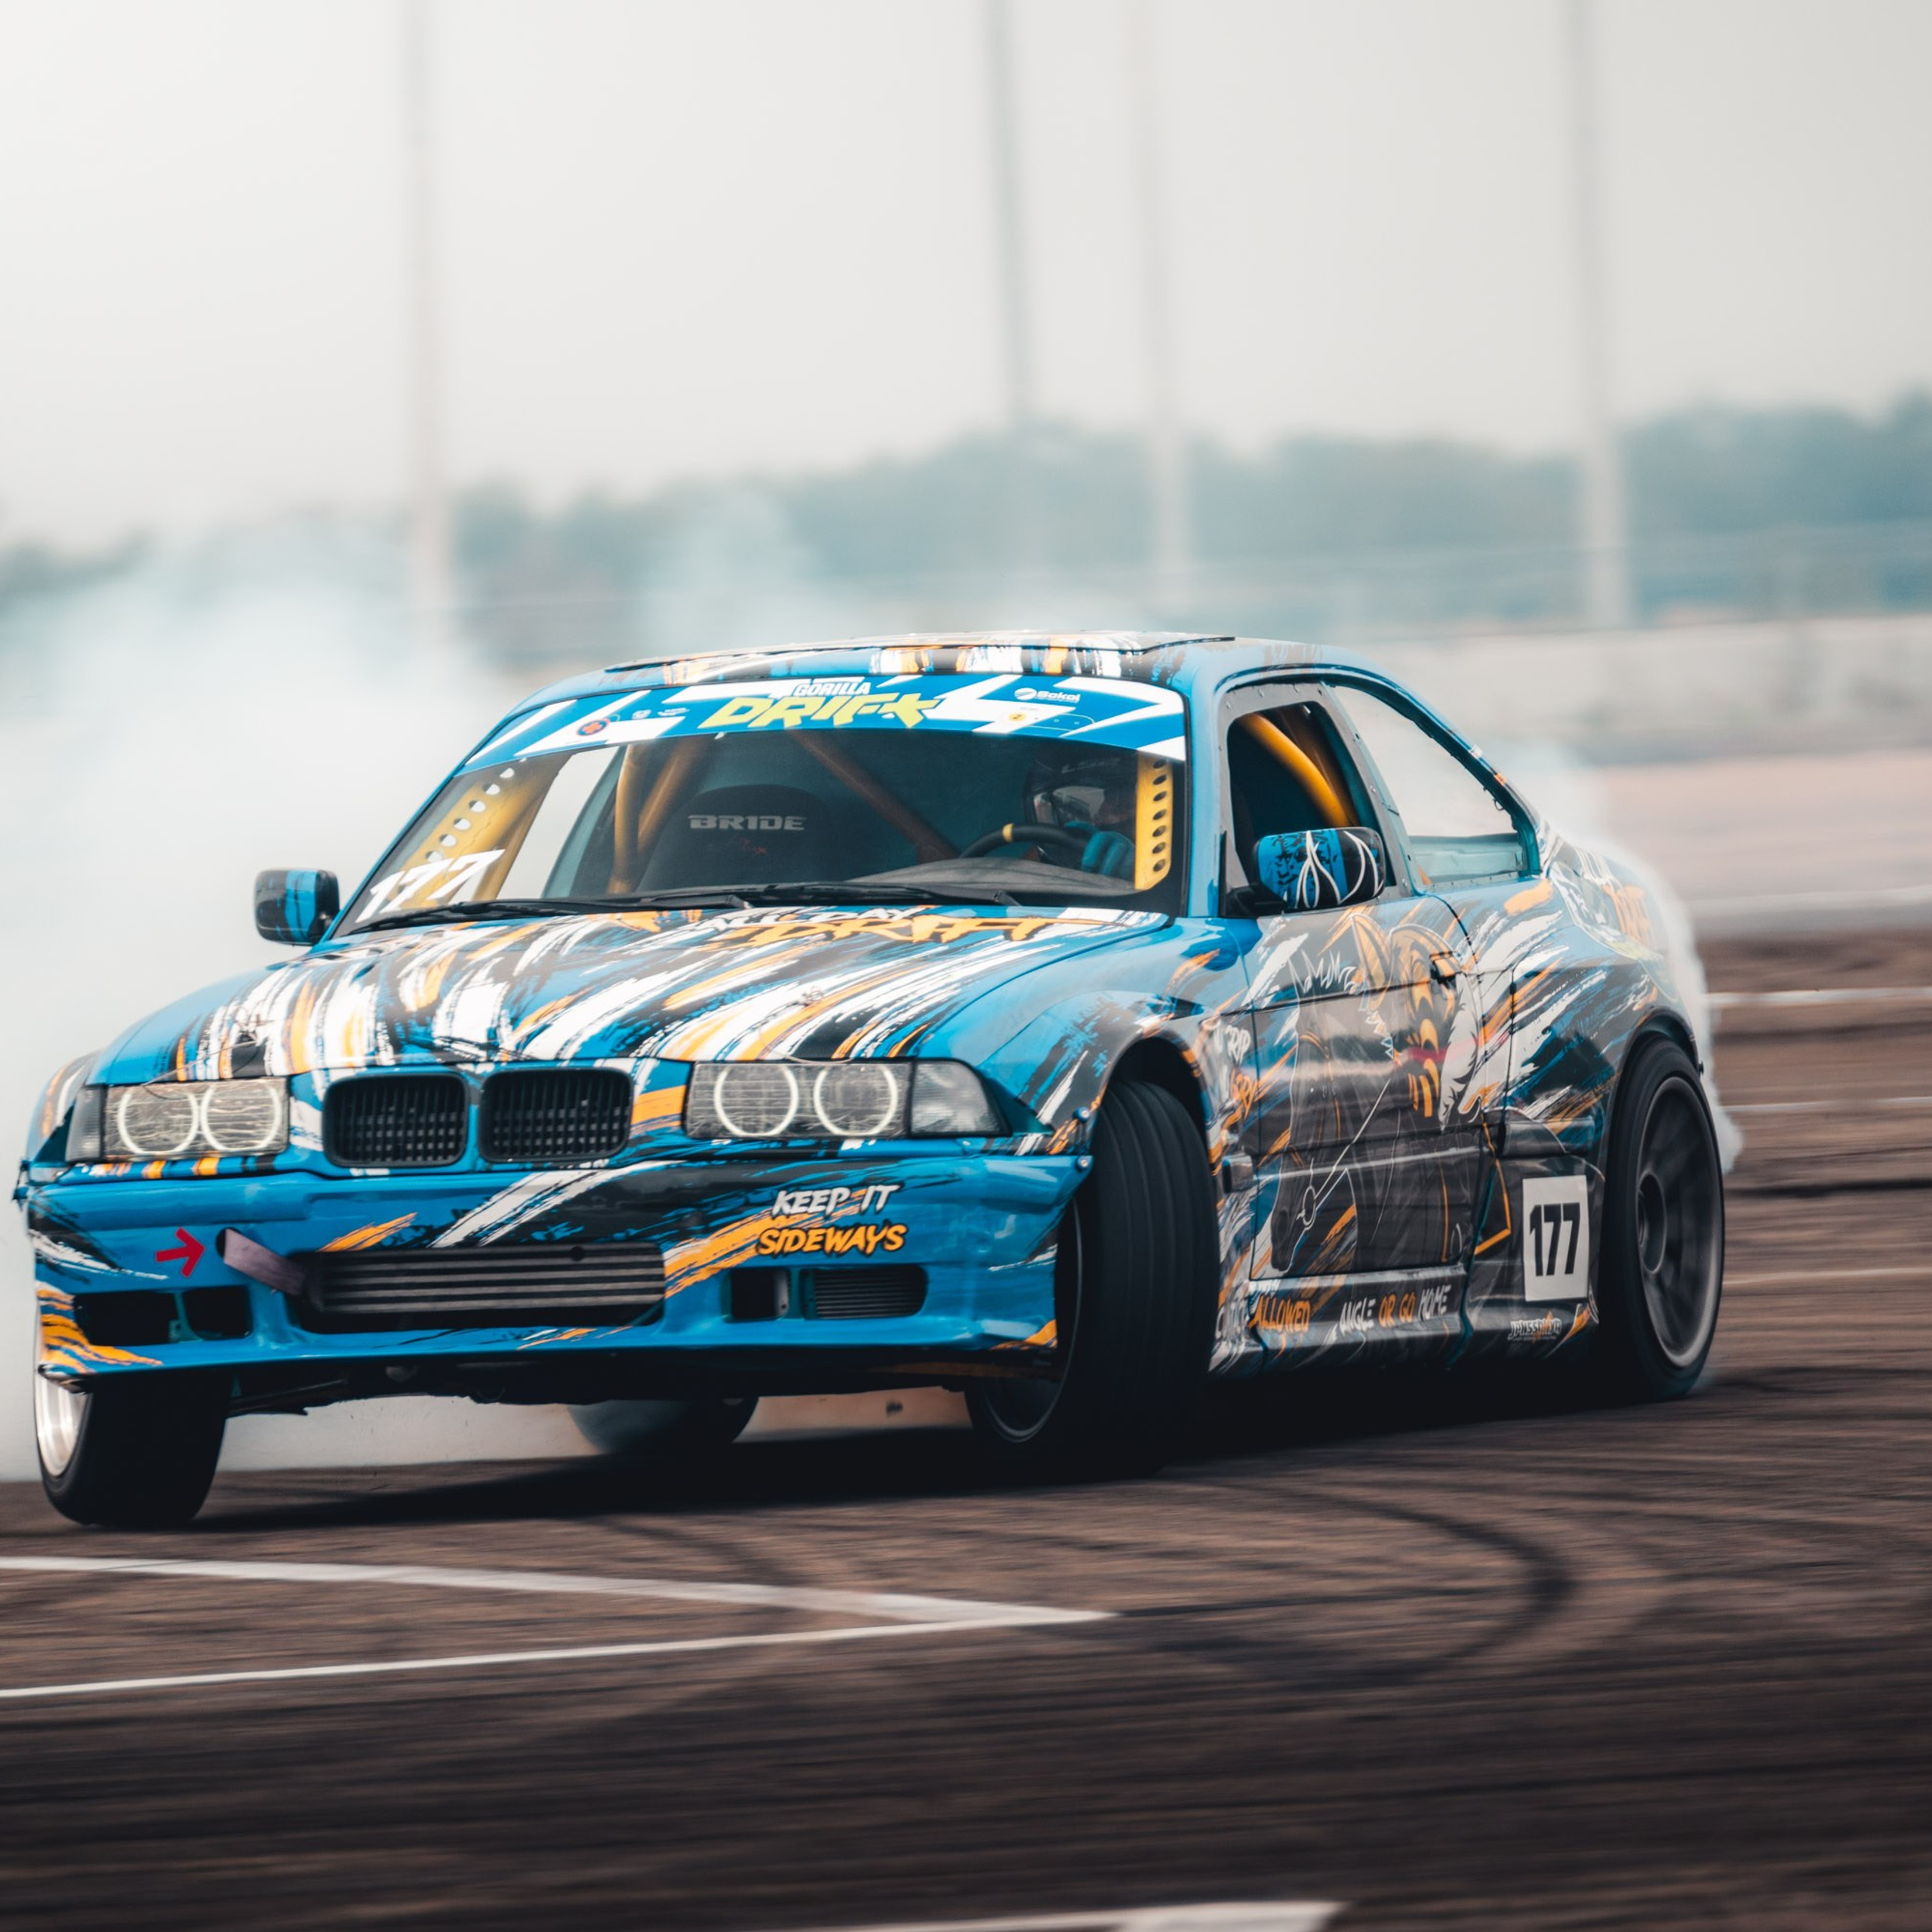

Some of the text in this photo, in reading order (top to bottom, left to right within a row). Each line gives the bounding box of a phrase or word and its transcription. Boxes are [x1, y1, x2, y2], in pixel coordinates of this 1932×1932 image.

[793, 681, 872, 697] GORILLA
[698, 692, 940, 729] DRIFT
[688, 814, 807, 831] BRIDE
[355, 849, 506, 923] 177
[771, 1184, 903, 1217] KEEP IT
[757, 1223, 908, 1256] SIDEWAYS
[1529, 1202, 1581, 1277] 177
[1249, 1295, 1311, 1333] ALLOWED
[1378, 1293, 1397, 1327] OR
[1399, 1291, 1417, 1323] GO
